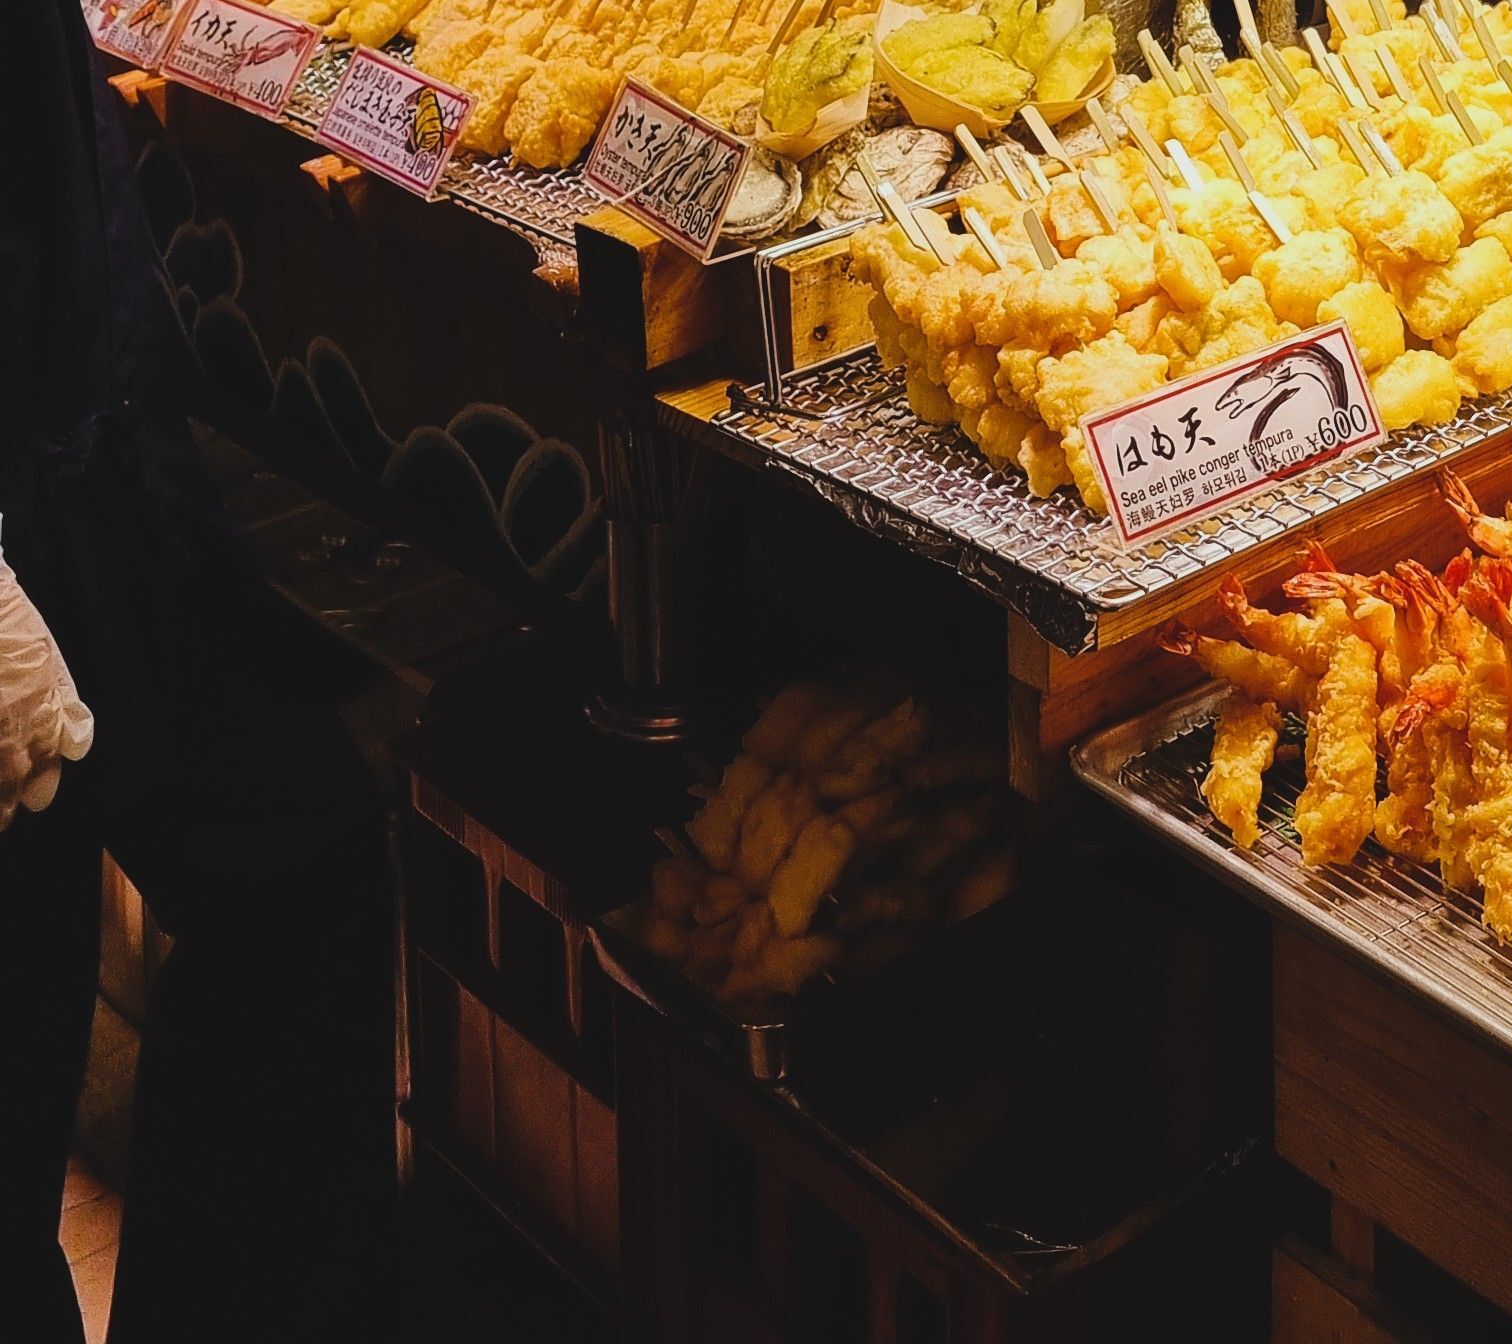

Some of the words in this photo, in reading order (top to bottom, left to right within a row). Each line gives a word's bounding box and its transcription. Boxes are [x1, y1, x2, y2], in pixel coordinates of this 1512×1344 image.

[1116, 406, 1216, 476] はも天
[1304, 404, 1367, 453] ¥600
[1120, 489, 1146, 508] Sea
[1148, 480, 1168, 499] eel
[1171, 465, 1197, 493] pike
[1199, 450, 1240, 483] conger
[1243, 428, 1294, 459] tempura
[1201, 467, 1248, 496] 하모튀김
